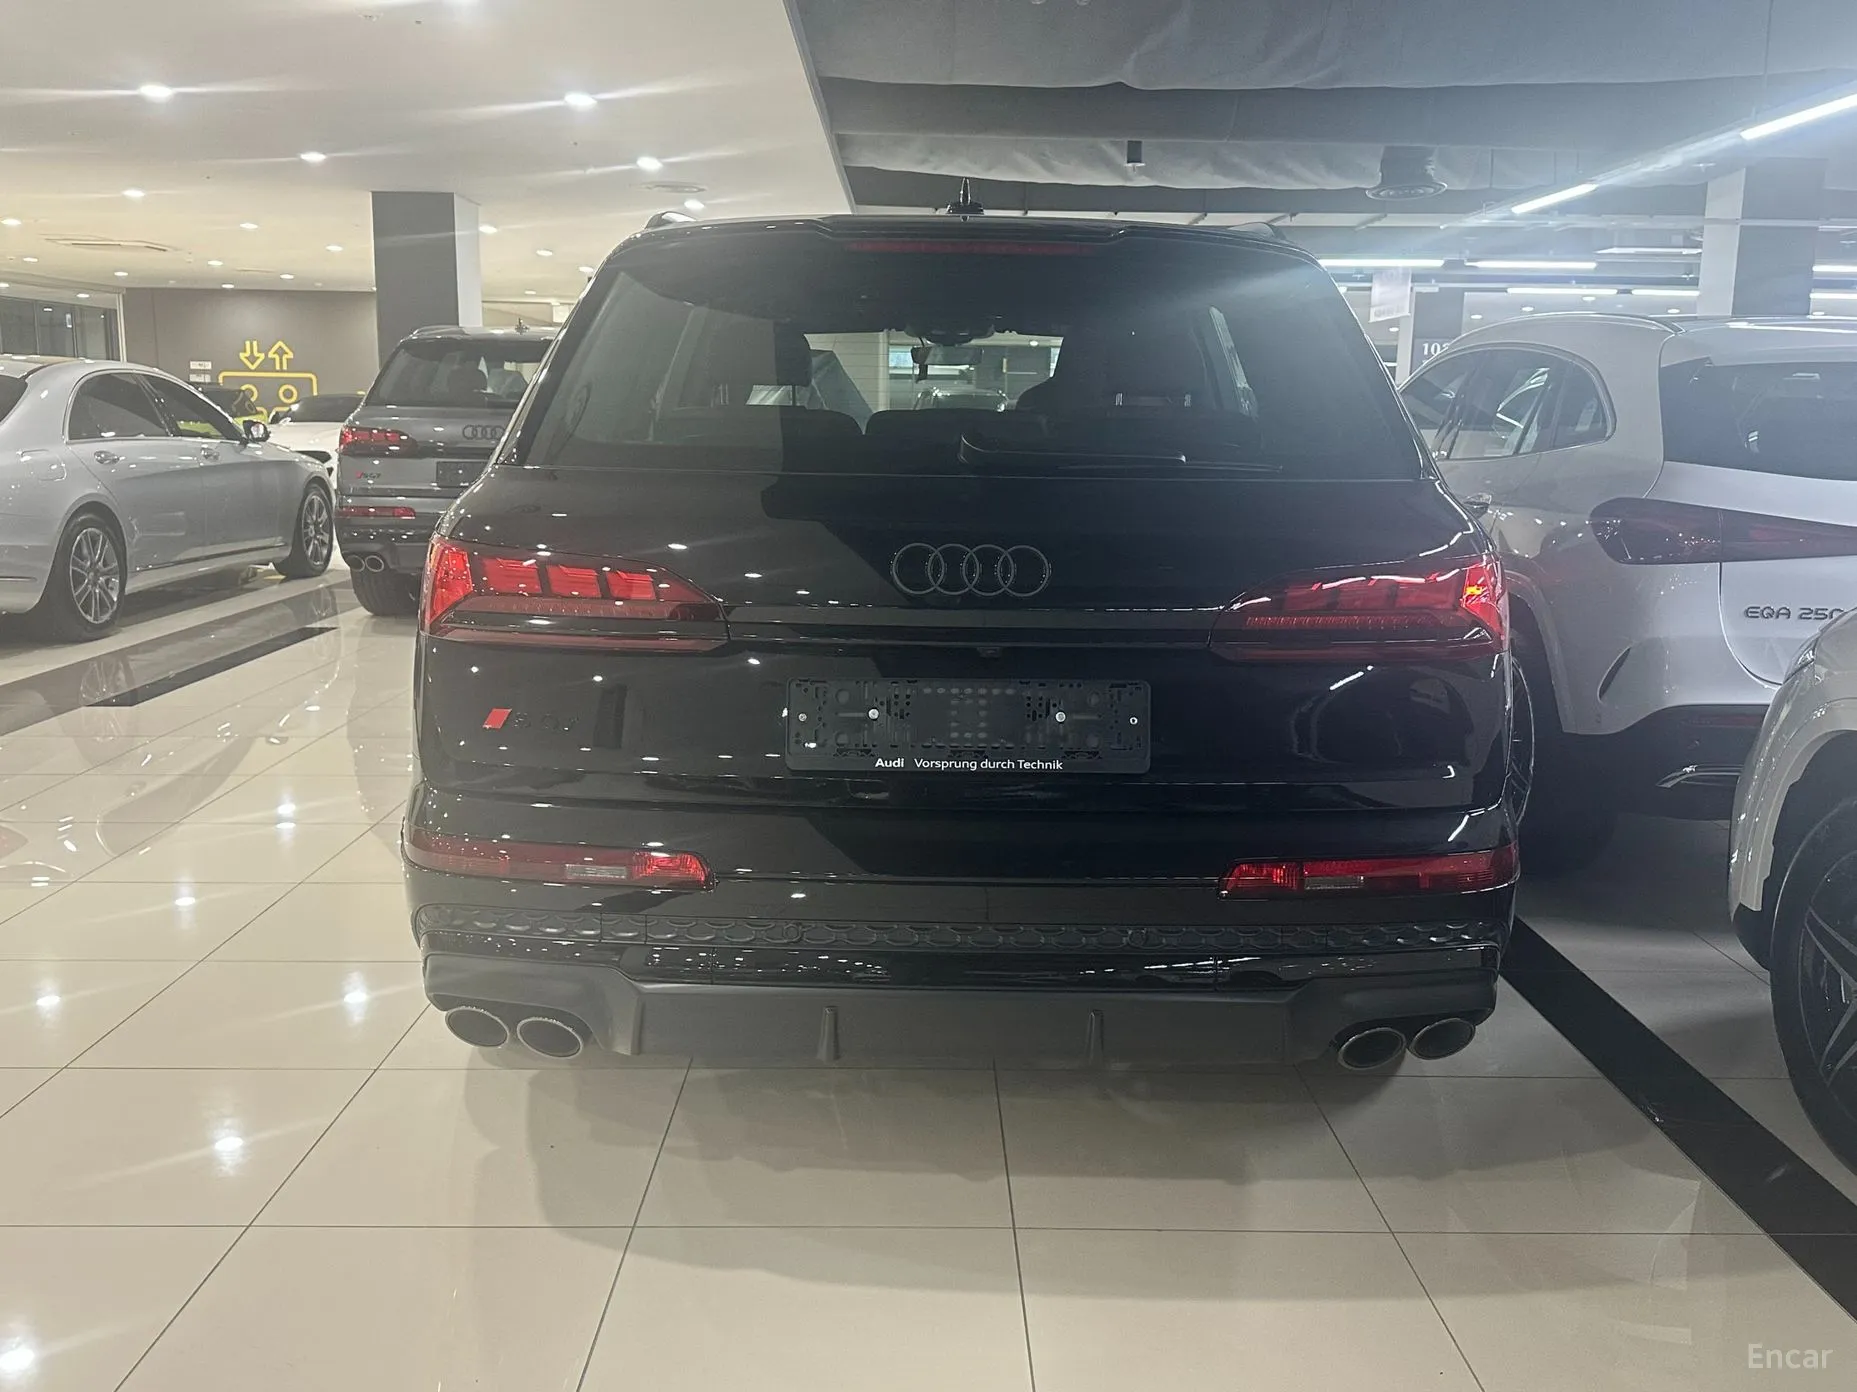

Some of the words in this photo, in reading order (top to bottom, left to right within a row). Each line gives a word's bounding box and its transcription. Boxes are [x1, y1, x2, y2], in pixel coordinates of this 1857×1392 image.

[1744, 606, 1791, 619] EQA
[875, 757, 904, 768] Audi
[914, 758, 977, 771] Vorsprung
[980, 758, 1015, 769] durch
[1017, 759, 1063, 770] Technik
